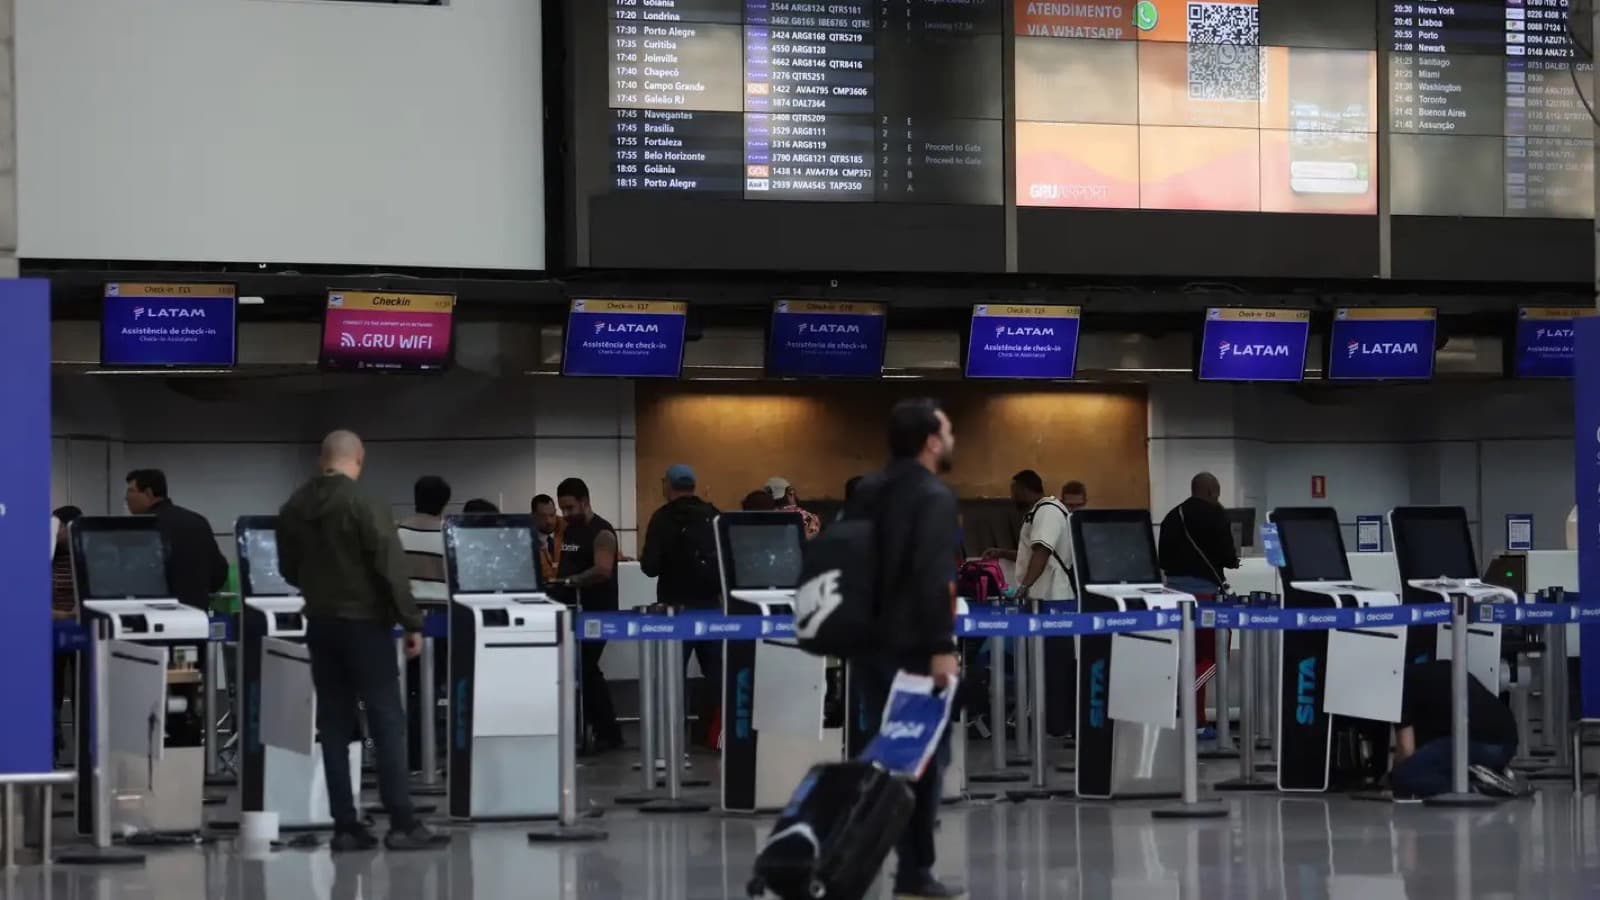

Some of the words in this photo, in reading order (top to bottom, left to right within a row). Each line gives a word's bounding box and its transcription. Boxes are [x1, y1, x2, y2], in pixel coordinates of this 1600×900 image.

[1027, 3, 1122, 19] ATENDIMENTO
[1418, 6, 1437, 14] Nova
[1438, 7, 1454, 15] York
[644, 12, 680, 20] Londrina
[1418, 19, 1442, 27] Lisboa
[616, 26, 636, 34] 17:30
[644, 27, 666, 36] Porto
[669, 27, 696, 37] Alegre
[1028, 26, 1050, 37] VIA
[1053, 26, 1122, 39] WHATSAPP
[1418, 31, 1438, 39] Porto
[616, 40, 636, 48] 17:35
[644, 40, 676, 49] Curitiba
[1418, 44, 1445, 52] Newark
[644, 54, 678, 63] Joinville
[1419, 58, 1450, 68] Santiago
[616, 81, 636, 89] 17:40
[644, 82, 673, 92] Campo
[675, 82, 704, 91] Grande
[1419, 83, 1461, 93] Washington
[645, 94, 674, 104] Galeão
[675, 96, 684, 104] RJ
[1419, 96, 1447, 104] Toronto
[616, 110, 636, 118] 17:45
[644, 111, 692, 120] Navegantes
[1419, 108, 1445, 116] Buenos
[1448, 109, 1466, 117] Aires
[616, 124, 636, 132] 17:45
[616, 138, 636, 146] 17:55
[644, 138, 682, 146] Fortaleza
[926, 143, 954, 151] Proceed
[965, 144, 981, 152] Gate
[644, 152, 663, 160] Belo
[665, 152, 705, 161] Horizonte
[616, 165, 636, 173] 18:05
[644, 165, 675, 174] Goiânia
[644, 179, 667, 188] Porto
[670, 180, 696, 189] Alegre
[372, 296, 410, 306] Checkin
[148, 308, 206, 318] LATAM
[122, 326, 167, 335] Assistência
[169, 327, 178, 335] de
[180, 327, 216, 336] check-in
[608, 324, 658, 333] LATAM
[810, 324, 860, 333] LATAM
[1007, 327, 1054, 336] LATAM
[400, 336, 432, 349] WIFI
[583, 341, 622, 349] Assistência
[624, 342, 634, 350] de
[636, 342, 667, 350] check-in
[837, 342, 868, 350] check-in
[984, 344, 1020, 352] Assistência
[1023, 344, 1032, 352] de
[1033, 344, 1062, 352] check-in
[1233, 344, 1289, 356] LATAM
[1362, 343, 1418, 354] LATAM
[1366, 612, 1394, 621] decolar
[1527, 610, 1553, 618] decolar
[1106, 618, 1137, 626] decolar
[1309, 615, 1336, 623] decolar
[642, 624, 674, 632] decolar
[775, 623, 794, 631] deco
[1088, 657, 1105, 729] SITA
[1296, 655, 1317, 727] SITA
[735, 666, 751, 744] SITA
